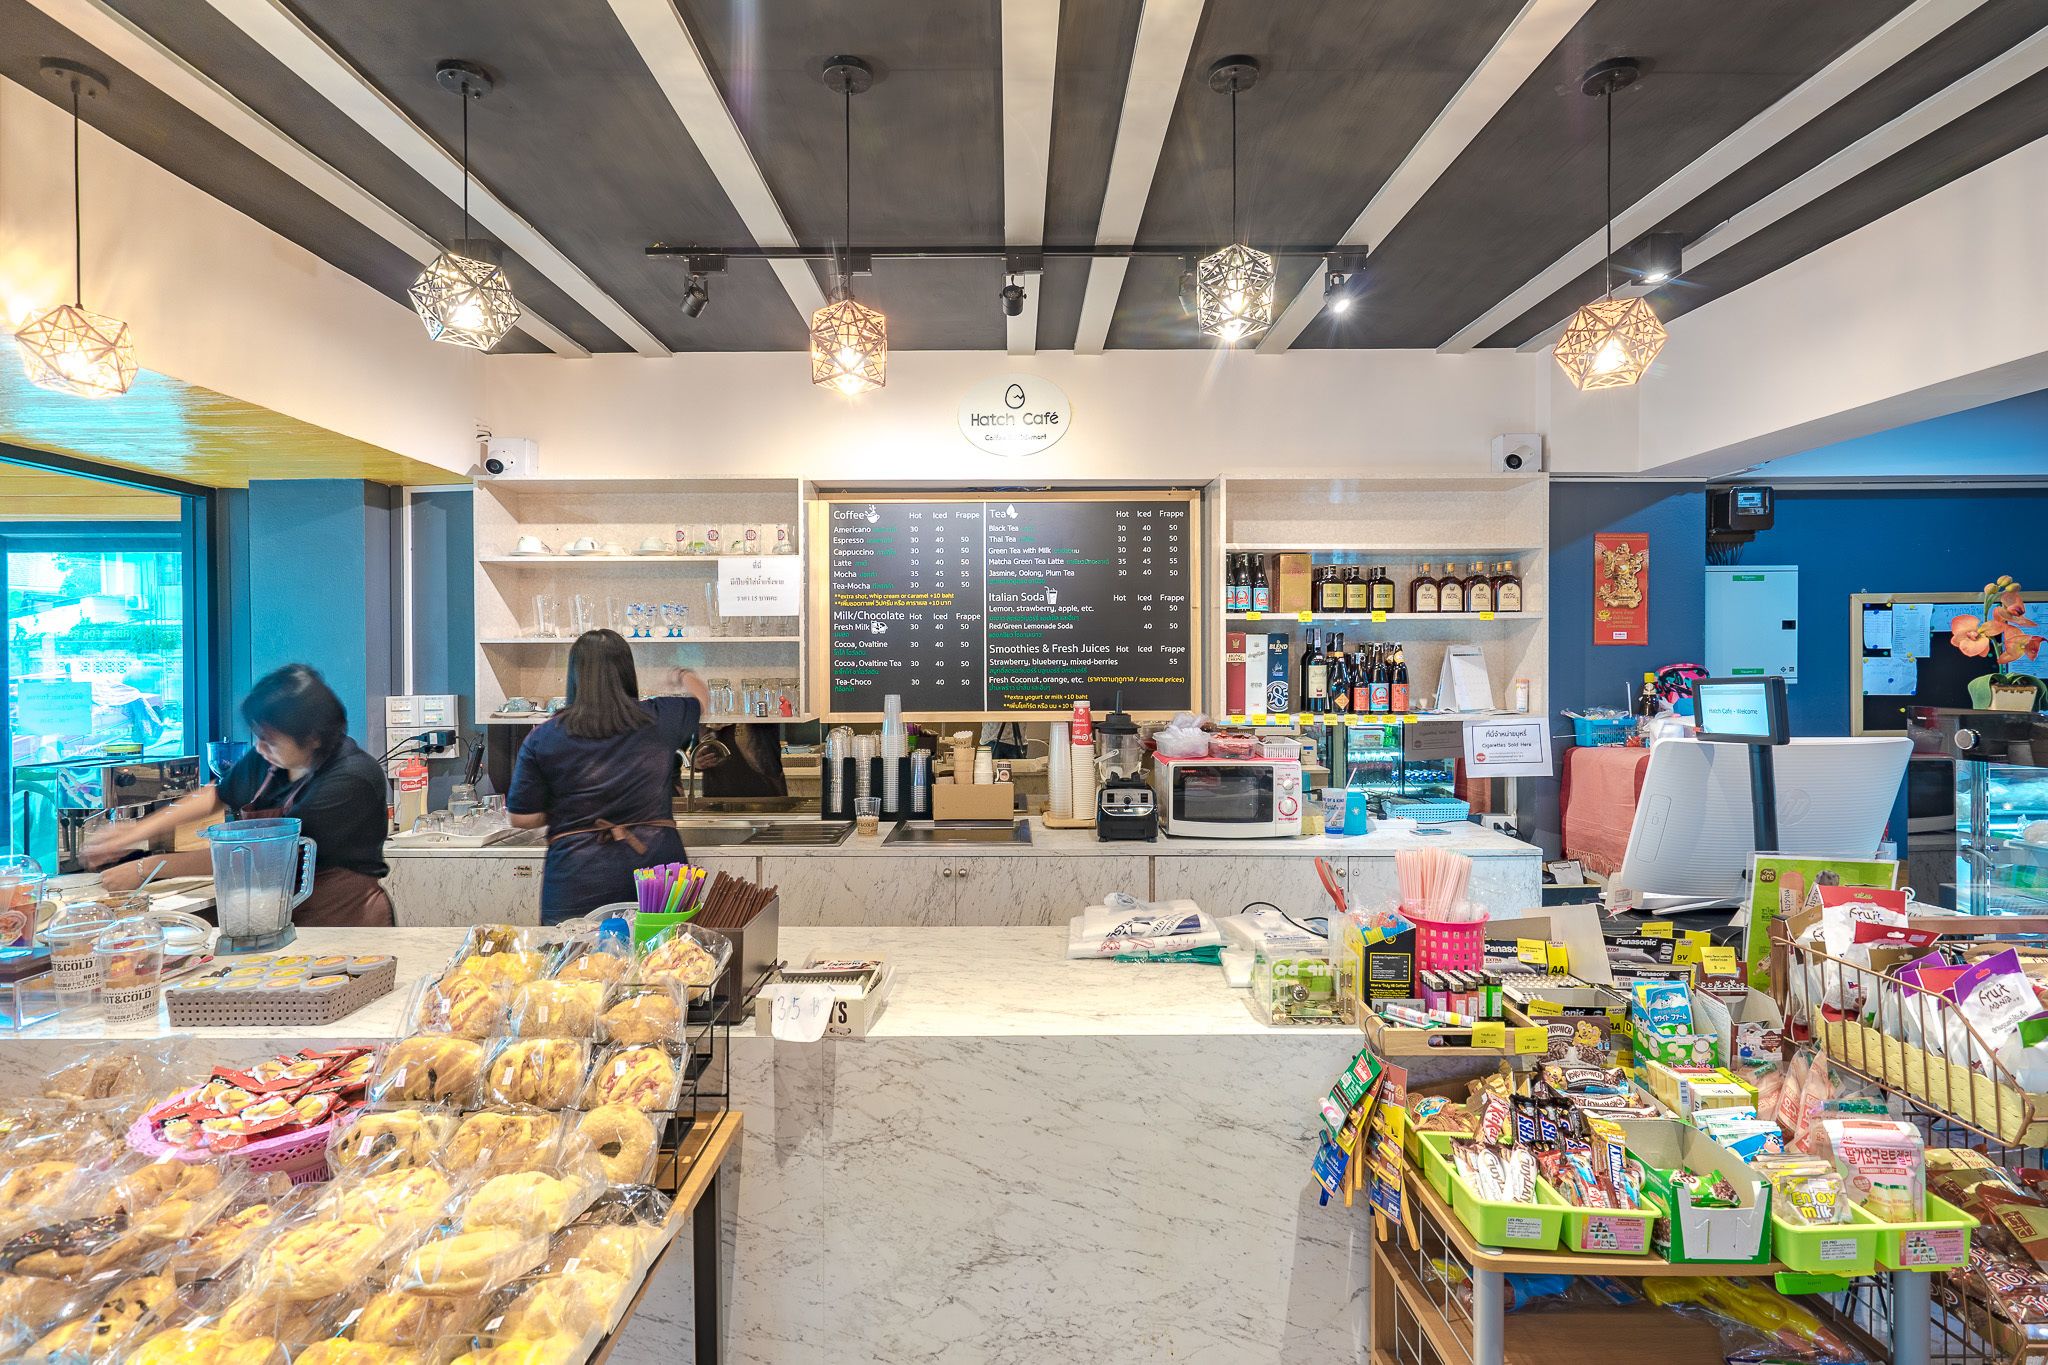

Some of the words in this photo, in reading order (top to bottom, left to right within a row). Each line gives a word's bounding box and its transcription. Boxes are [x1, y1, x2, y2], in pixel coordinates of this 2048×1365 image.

[971, 413, 1015, 426] Hatch
[1023, 412, 1059, 425] Café
[834, 511, 864, 520] Coffee
[990, 510, 1006, 518] Tea
[989, 593, 1018, 601] Italian
[1021, 593, 1044, 601] Soda
[834, 611, 904, 620] Milk/Chocolate
[990, 645, 1039, 653] Smoothies
[1052, 644, 1078, 653] Fresh
[1081, 644, 1109, 653] Juices
[1485, 944, 1517, 953] Panaso
[1792, 1189, 1836, 1206] Enjoy
[1800, 1204, 1832, 1219] milk
